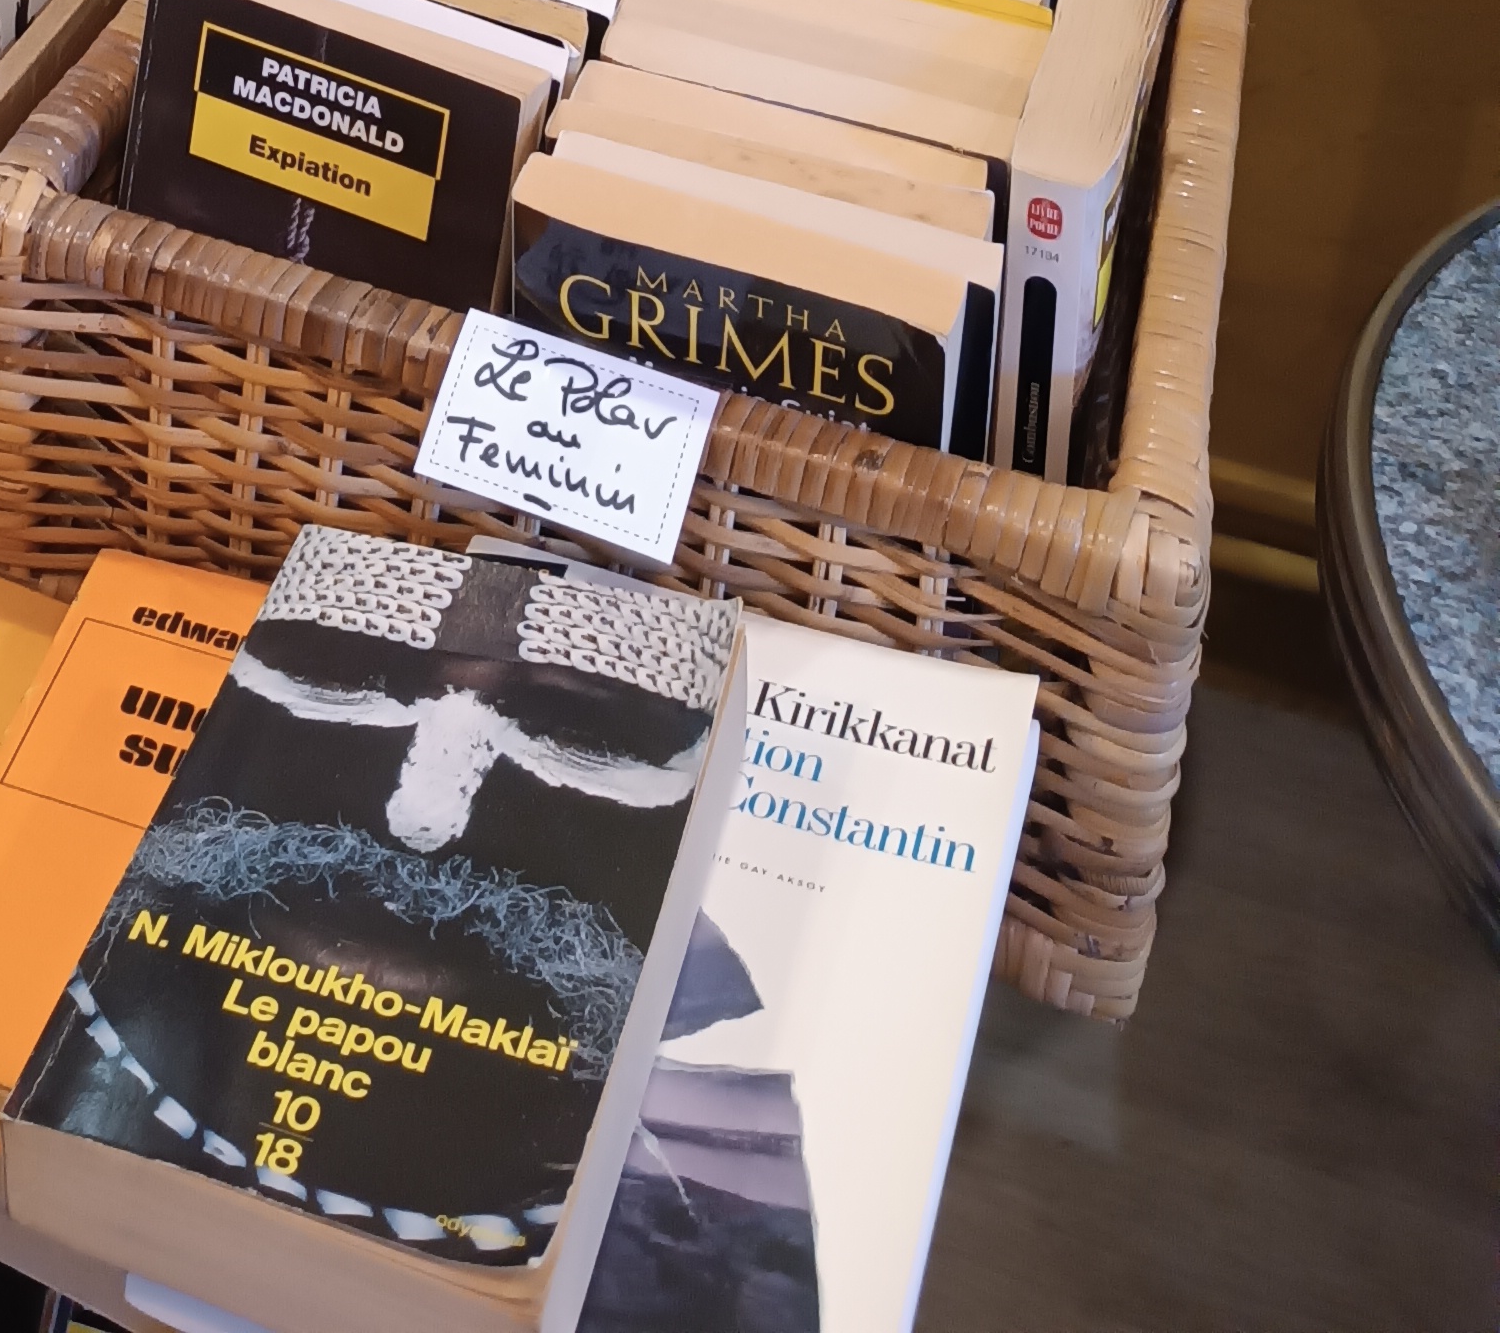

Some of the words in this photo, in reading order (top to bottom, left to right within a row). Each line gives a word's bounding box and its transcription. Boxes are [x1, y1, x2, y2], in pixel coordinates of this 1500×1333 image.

[232, 75, 405, 155] MACDONALD
[261, 56, 382, 120] PATRICIA
[248, 134, 372, 198] Expiation
[636, 264, 849, 343] MARTHA
[473, 337, 540, 404] Le
[557, 272, 897, 417] GRIMES
[526, 417, 582, 451] au
[752, 679, 998, 775] Kirikkanat
[726, 769, 977, 874] Constantin
[127, 909, 171, 948] N.
[180, 923, 580, 1073] Mikloukho-Maklaï
[221, 979, 281, 1023] Le
[284, 1003, 434, 1075] papou
[246, 1029, 373, 1100] blanc
[271, 1088, 322, 1132] 10
[253, 1131, 304, 1176] 18
